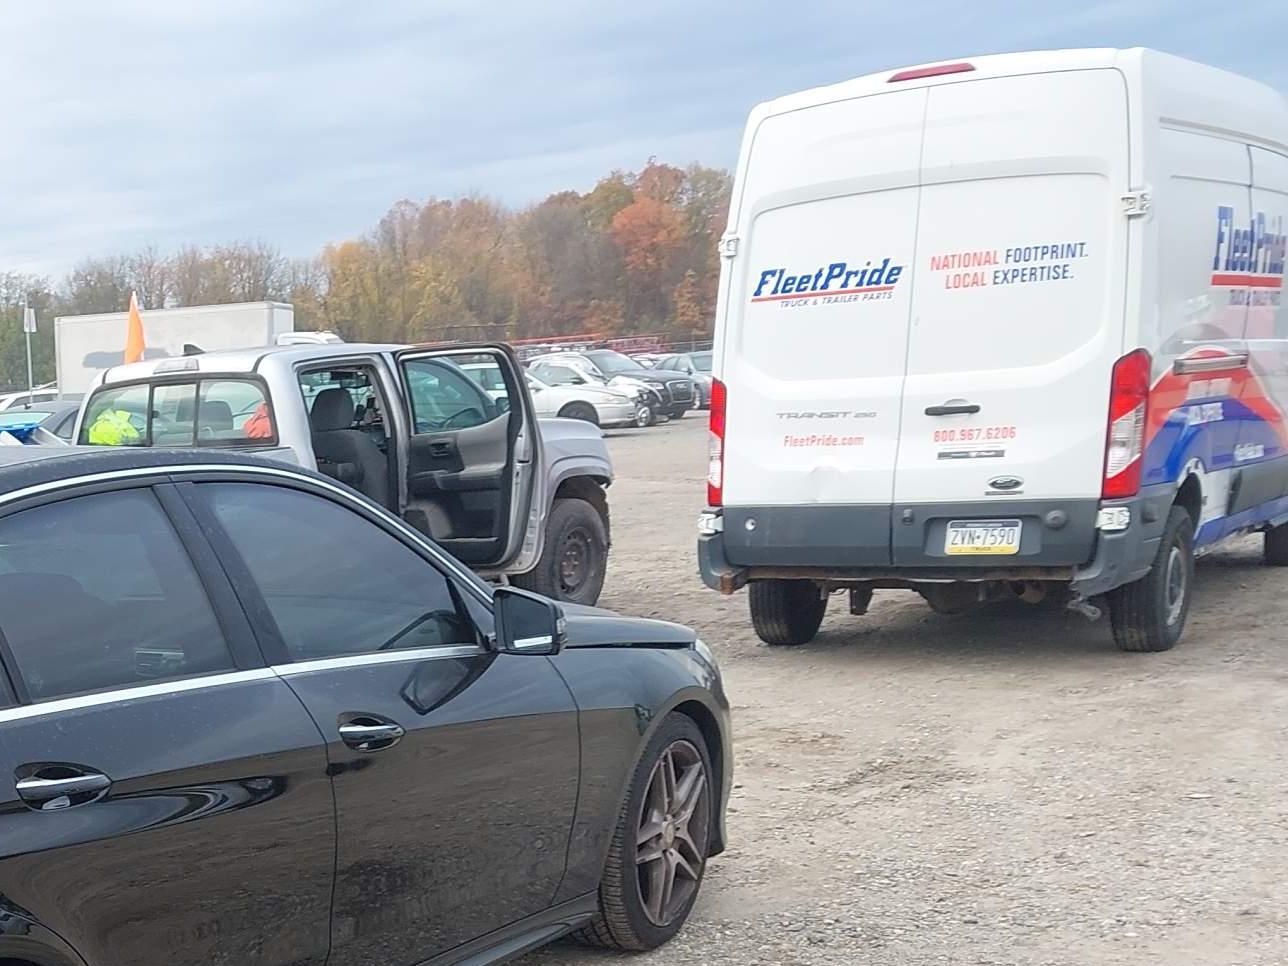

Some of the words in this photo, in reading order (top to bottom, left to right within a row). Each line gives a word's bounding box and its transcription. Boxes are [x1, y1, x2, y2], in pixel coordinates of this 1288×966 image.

[1213, 205, 1287, 272] FleetPr
[930, 250, 1000, 271] NATIONAL
[1005, 242, 1089, 264] FOOTPRINT.
[753, 258, 904, 297] FleetPride
[945, 271, 987, 290] LOCAL
[992, 264, 1075, 286] EXPERTISE.
[780, 299, 809, 309] TRUCK
[822, 295, 859, 305] TRAILER
[862, 291, 894, 301] PARTS
[783, 434, 865, 447] FleetPride.com
[934, 426, 1017, 442] 800.967.6206
